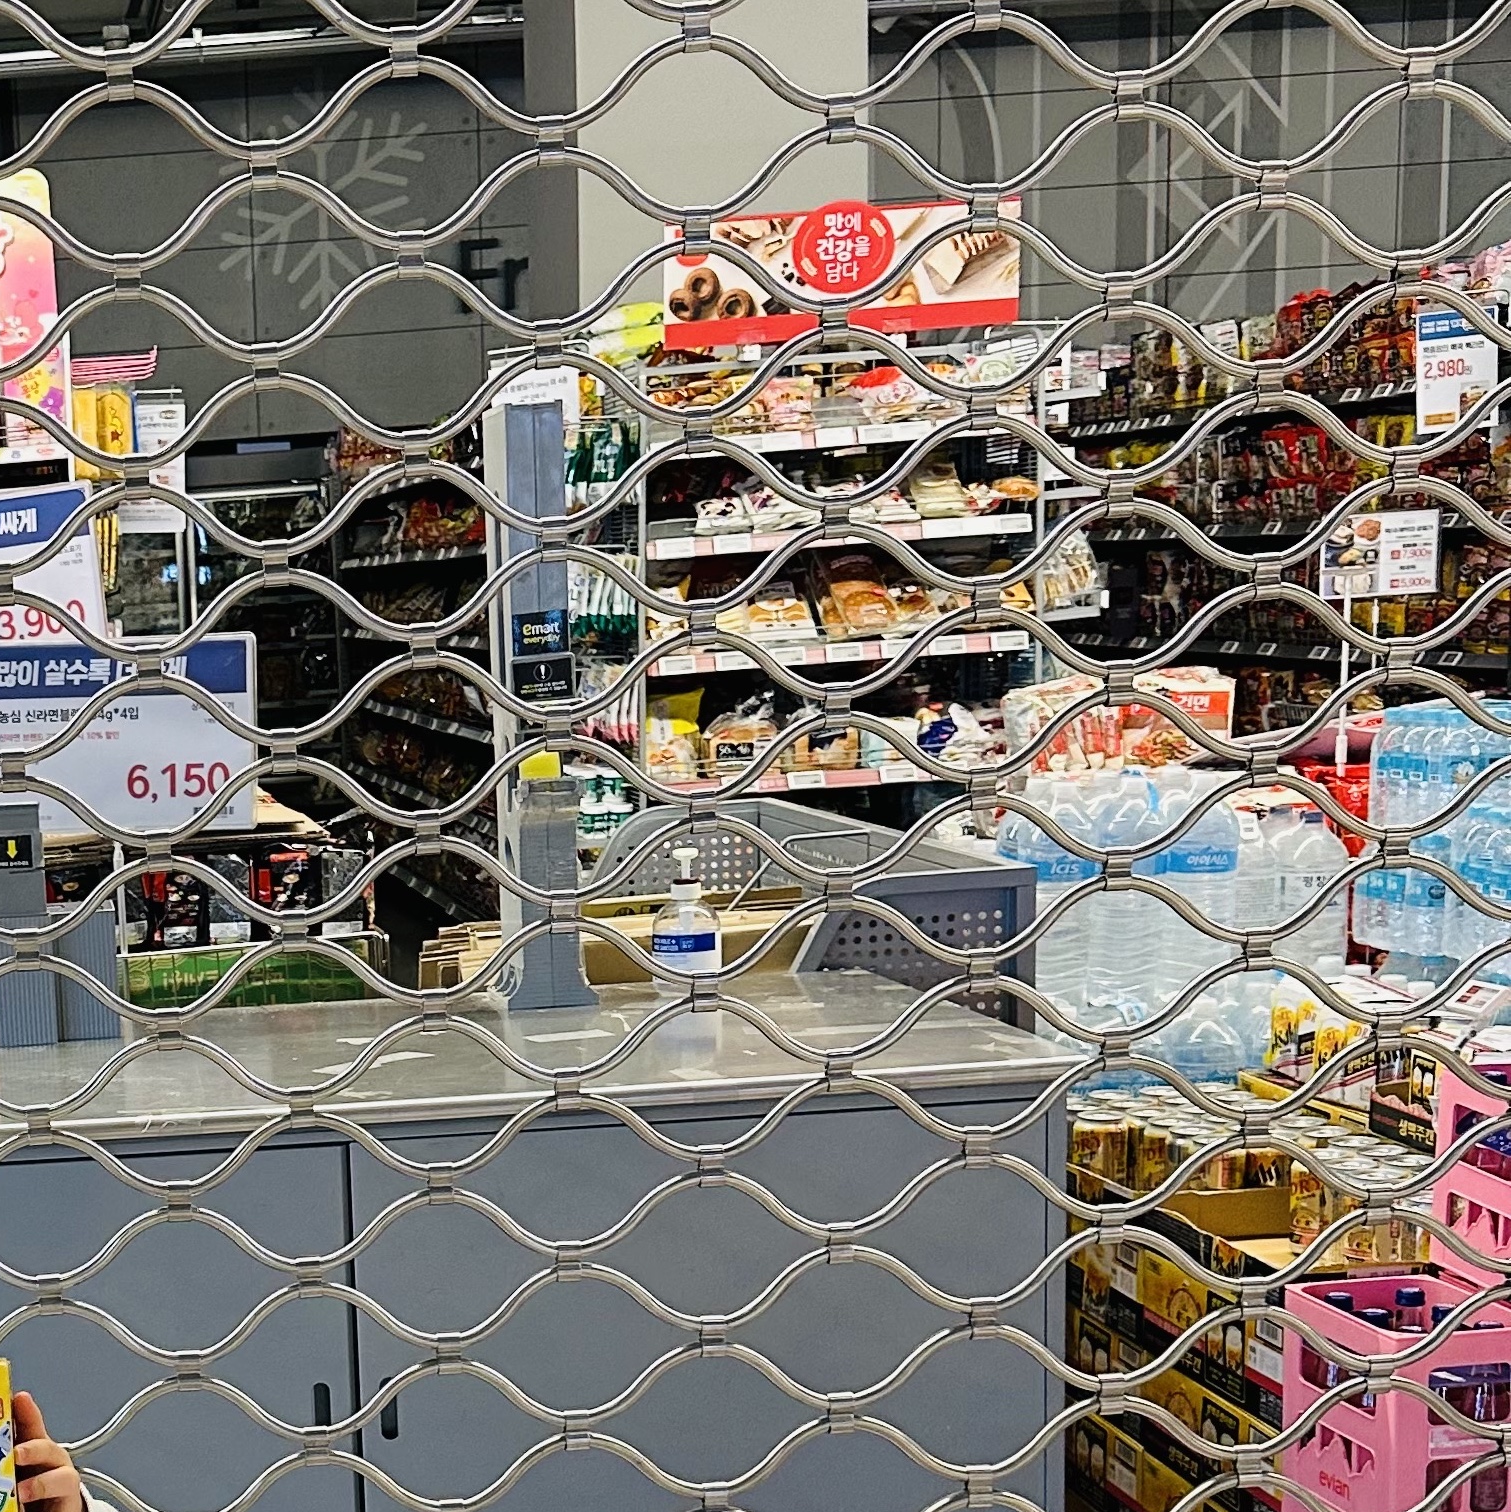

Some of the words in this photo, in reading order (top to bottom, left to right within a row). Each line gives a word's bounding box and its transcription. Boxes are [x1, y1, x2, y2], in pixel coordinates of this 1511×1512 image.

[824, 211, 862, 236] 맛에
[816, 236, 871, 262] 건강을
[825, 262, 861, 283] 담다
[0, 507, 38, 537] 싸게
[522, 621, 561, 636] emart
[523, 633, 561, 646] everyday
[43, 658, 111, 687] 살수록
[127, 761, 230, 804] 6,150
[1318, 1470, 1351, 1502] evian
